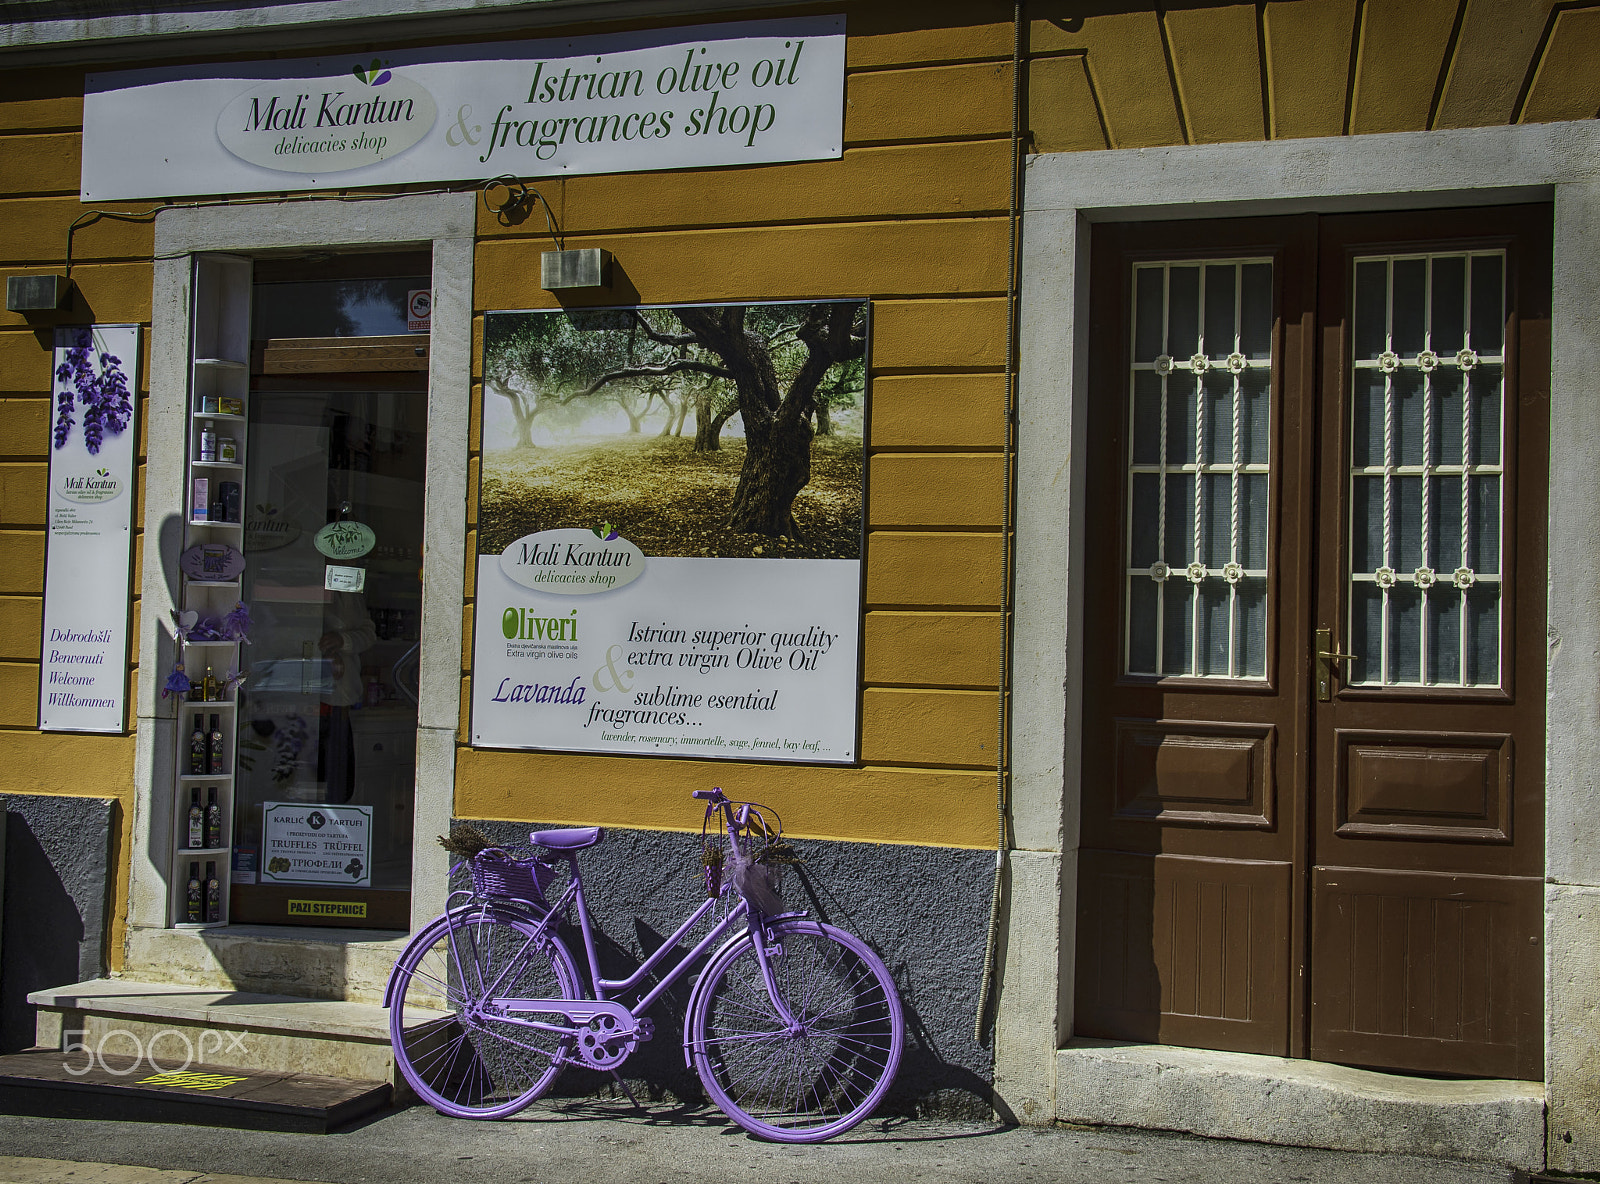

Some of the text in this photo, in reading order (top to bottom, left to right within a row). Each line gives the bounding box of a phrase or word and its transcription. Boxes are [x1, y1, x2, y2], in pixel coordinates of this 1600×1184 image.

[524, 40, 804, 103] Istrian olive oil
[242, 92, 415, 131] Mali Kantun
[446, 104, 482, 147] &
[479, 91, 776, 163] fragrances shop
[274, 132, 388, 155] delicacies shop
[64, 477, 117, 489] Mali Kantun
[246, 519, 289, 532] antun
[517, 542, 632, 567] Mali Kantun
[534, 570, 616, 588] delicacies shop
[50, 628, 112, 643] Dobrodošli
[627, 621, 839, 654] Istrian superior quality
[49, 650, 105, 664] Benvenuti
[506, 649, 578, 660] Extra virgin olive oils
[627, 646, 820, 674] extra virgin Olive Oil
[49, 671, 95, 686] Welcome
[592, 644, 635, 693] &
[48, 692, 115, 708] Willkommen
[491, 676, 587, 705] Lavanda
[633, 685, 779, 711] sublime esential
[583, 701, 703, 730] fragrances...
[601, 730, 636, 743] lavender,
[638, 734, 678, 747] rosemary,
[680, 733, 727, 748] immortelle,
[729, 738, 750, 750] sage,
[751, 737, 781, 751] fennel,
[783, 738, 801, 753] bay
[273, 815, 304, 825] KARLIĆ
[328, 818, 363, 827] TARTUFI
[271, 839, 364, 852] TRUFFLES TRÜFFEL
[291, 858, 342, 869] ТРЮФЕЛИ
[290, 902, 364, 915] PAZI STEPENICE
